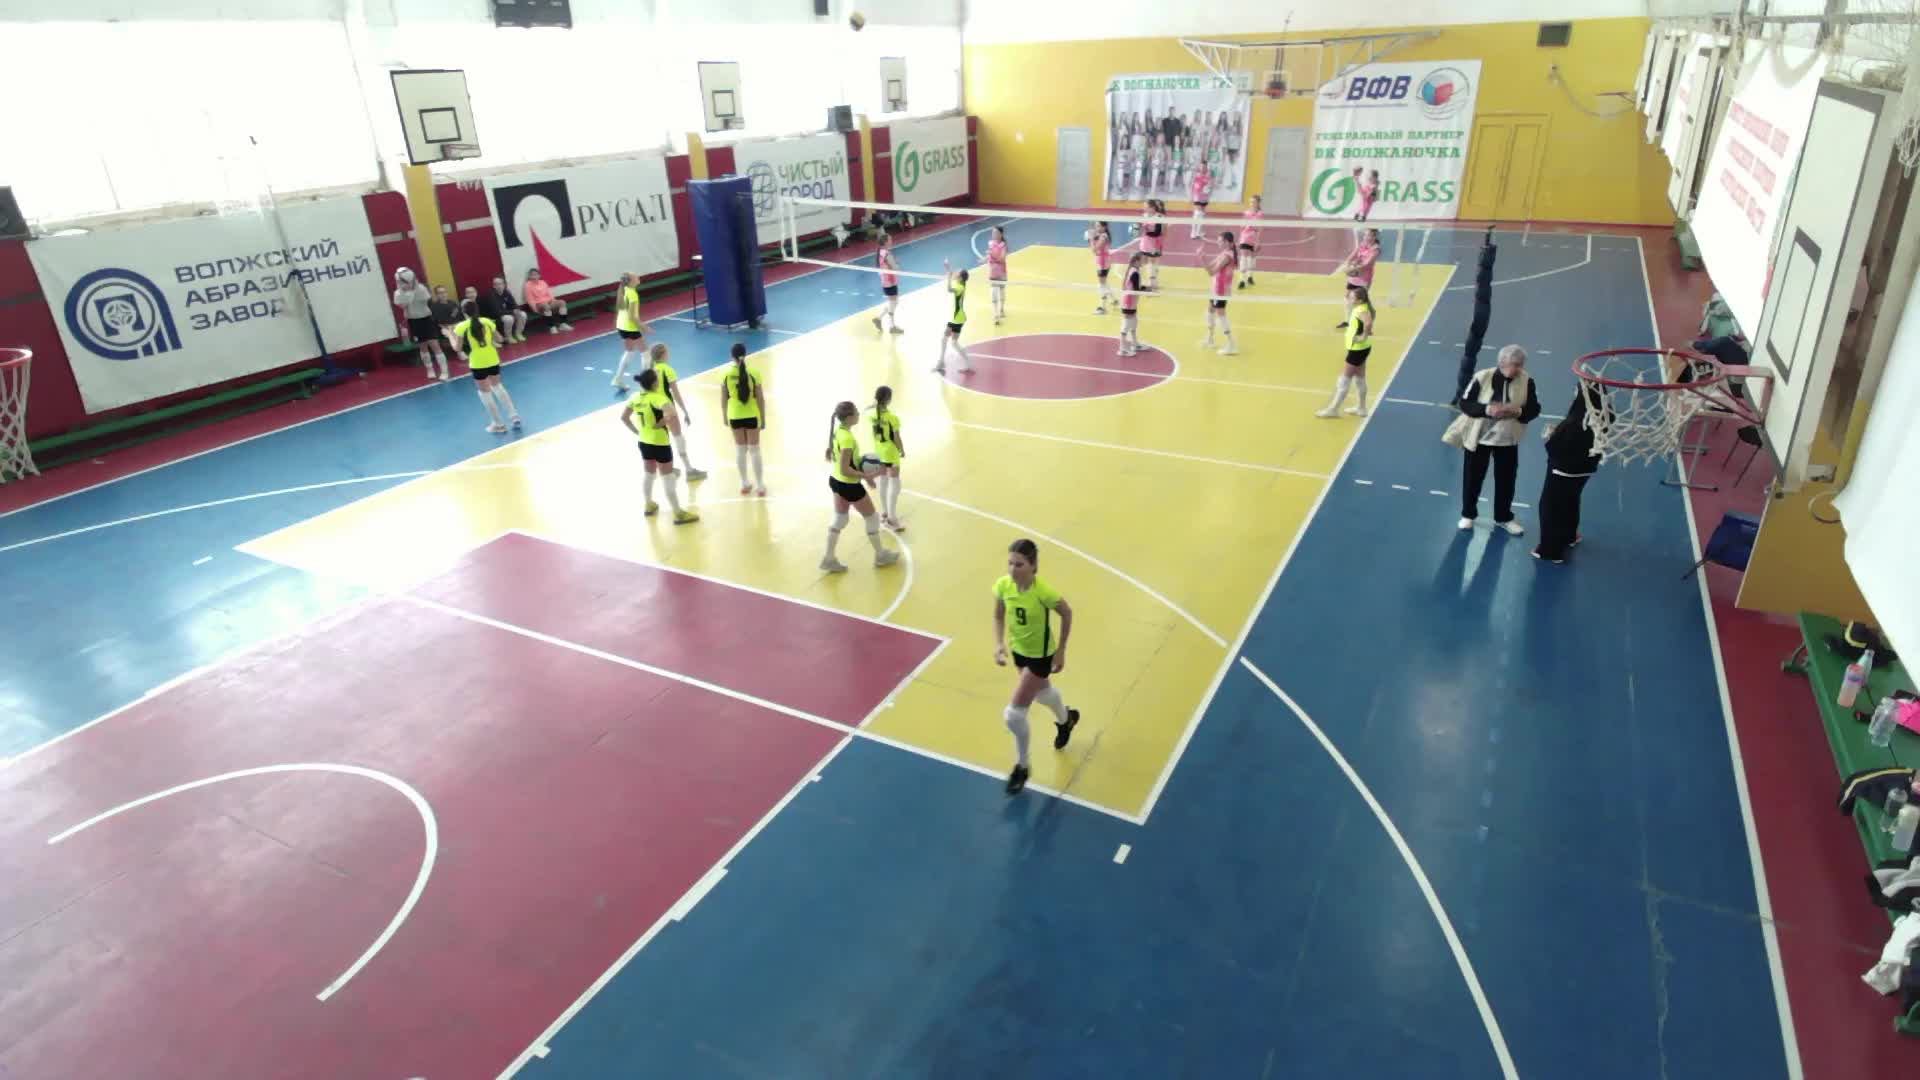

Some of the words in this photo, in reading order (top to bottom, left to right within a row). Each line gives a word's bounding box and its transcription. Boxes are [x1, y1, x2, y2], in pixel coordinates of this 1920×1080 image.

[1346, 75, 1412, 100] ВФВ
[1316, 129, 1403, 140] ГЕНЕРАЛЬНЫЙ
[1407, 129, 1464, 140] ПАРТНЕР
[922, 145, 965, 174] GRASS
[1342, 147, 1460, 158] ВОЛЖАНОЧКА
[777, 151, 844, 184] ЧИСТЫЙ
[780, 179, 835, 200] ГОРОД
[1374, 180, 1455, 203] RASS
[576, 193, 668, 235] РУСАЛ
[174, 238, 340, 283] ВОЛЖСКИЙ
[185, 256, 372, 307] АБРАЗИВНЫЙ
[1015, 606, 1028, 626] 9
